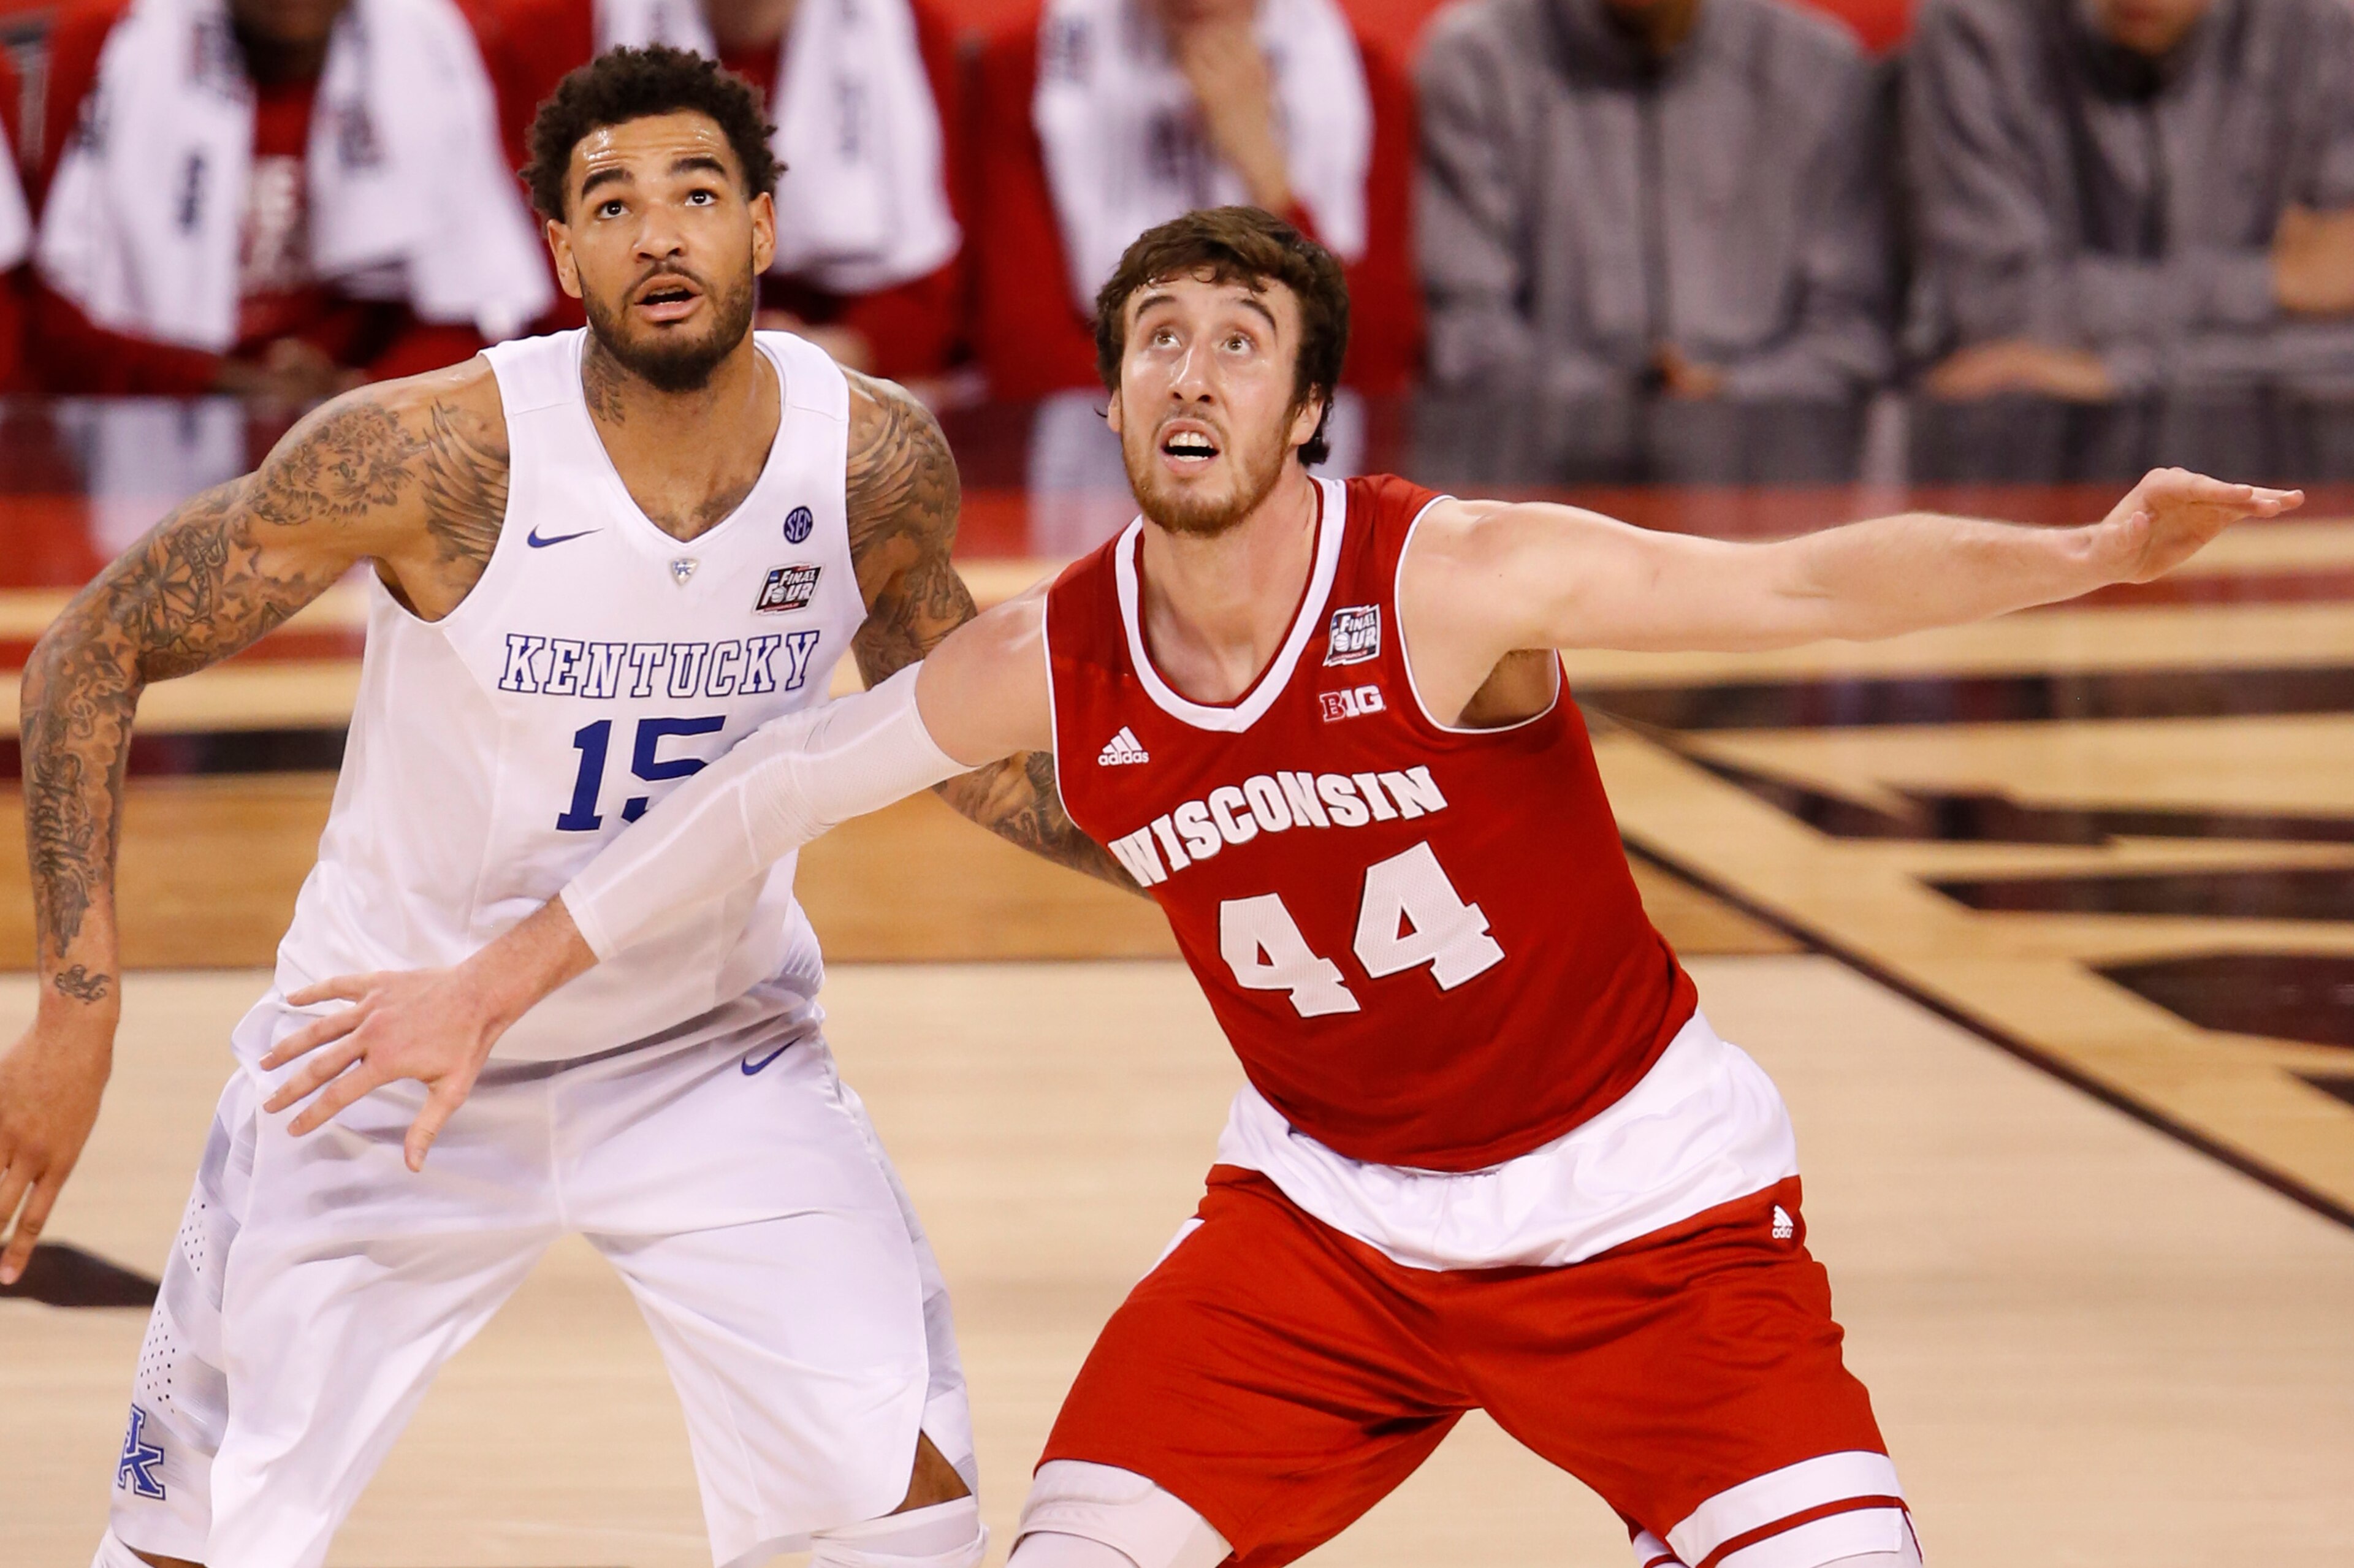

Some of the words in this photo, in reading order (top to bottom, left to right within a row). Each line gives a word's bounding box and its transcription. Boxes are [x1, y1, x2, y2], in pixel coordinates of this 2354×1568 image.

[787, 509, 811, 541] SEC
[779, 569, 816, 586] FINAL
[760, 582, 814, 606] FOUR
[1339, 612, 1376, 633] FINAL
[498, 630, 820, 699] KENTUCKY
[555, 715, 726, 831] 15
[1097, 750, 1149, 767] adidas
[1107, 764, 1449, 888] WISCONSIN
[1219, 839, 1506, 1019] 44
